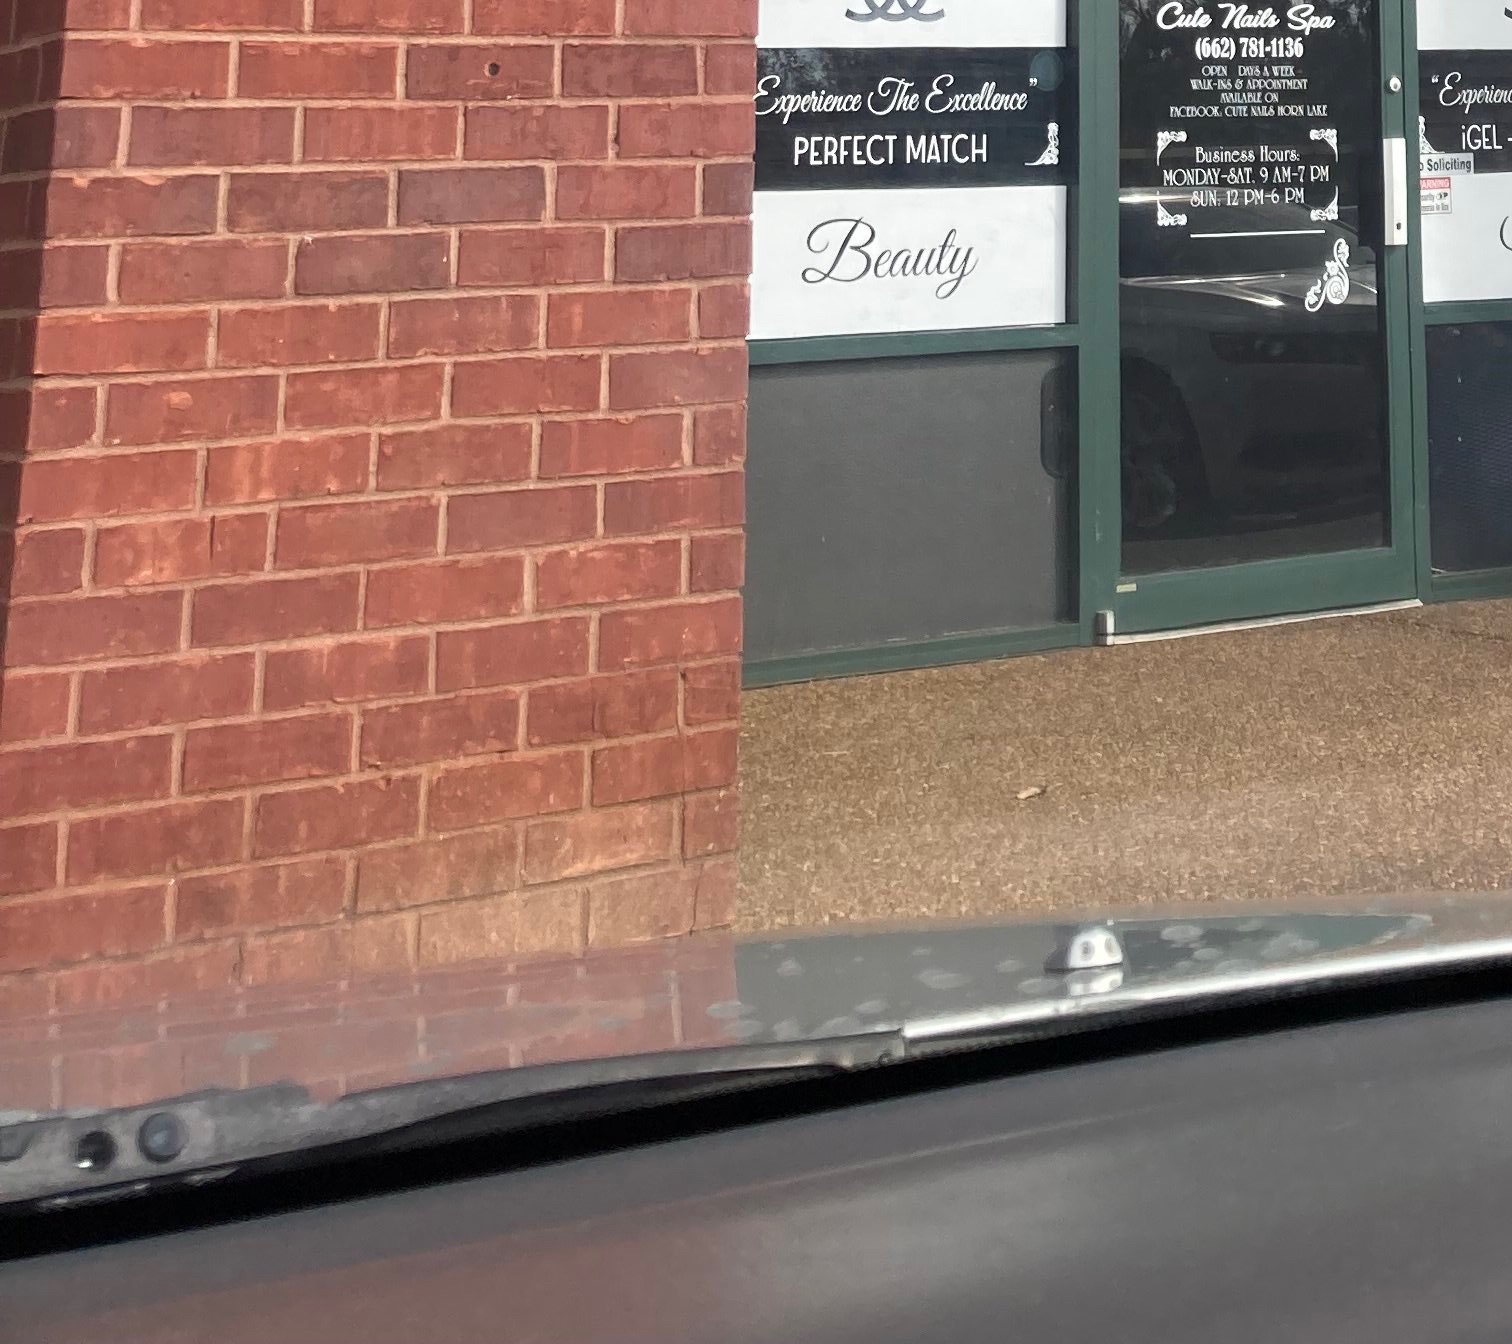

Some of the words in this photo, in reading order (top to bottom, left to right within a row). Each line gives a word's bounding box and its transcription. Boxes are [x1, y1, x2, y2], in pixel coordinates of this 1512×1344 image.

[1156, 1, 1212, 30] Cute
[1217, 2, 1280, 29] Nails
[1287, 3, 1336, 35] Spa
[1195, 37, 1236, 60] (662)
[1239, 37, 1304, 58] 781-1136
[1201, 65, 1228, 76] OPEN
[1238, 65, 1260, 76] DAYS
[1262, 66, 1270, 76] A
[1272, 65, 1295, 76] WEEK
[1190, 79, 1232, 90] WALK-INS
[1235, 79, 1243, 90] &
[1246, 79, 1308, 90] APPOINTMENT
[753, 74, 862, 124] Experience
[867, 76, 919, 115] The
[1220, 92, 1262, 103] AVAILABLE
[1264, 92, 1279, 103] ON
[1225, 105, 1248, 117] CUTE
[1251, 105, 1275, 117] NAILS
[1278, 105, 1304, 117] HORN
[1307, 104, 1328, 116] LAKE
[1461, 124, 1503, 151] iGEL
[794, 134, 897, 165] PERFECT
[906, 133, 987, 164] MATCH
[1195, 145, 1255, 163] Business
[1260, 145, 1300, 162] Hours:
[1260, 166, 1269, 183] 9
[1273, 165, 1306, 183] AM-7
[1310, 164, 1330, 182] PM
[1427, 158, 1471, 173] Soliciting
[1420, 178, 1450, 189] ARNING
[1226, 189, 1239, 206] 12
[1244, 188, 1279, 205] PM-6
[1285, 187, 1305, 204] PM
[801, 216, 978, 300] Beauty
